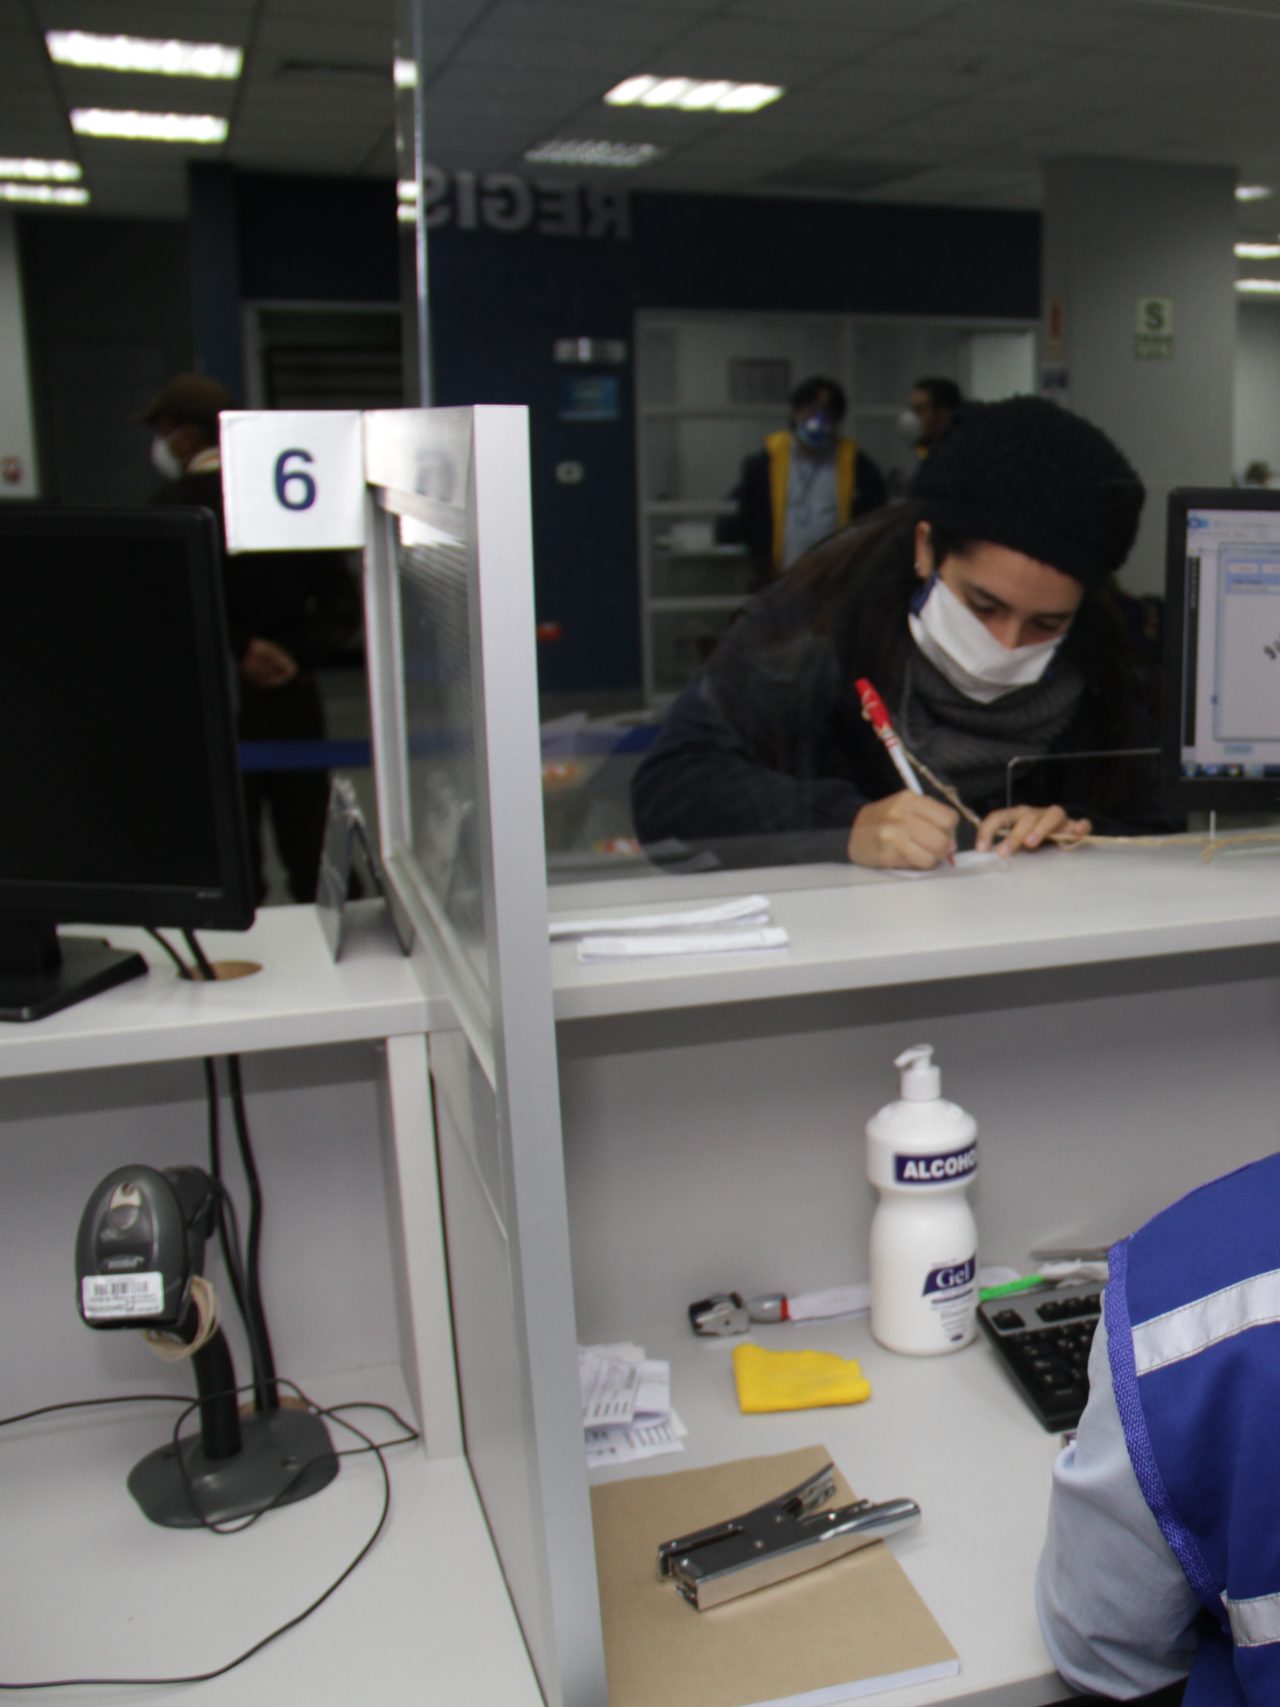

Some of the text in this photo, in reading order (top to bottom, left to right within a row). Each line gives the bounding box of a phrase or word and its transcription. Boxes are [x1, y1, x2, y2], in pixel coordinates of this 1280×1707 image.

[1145, 302, 1165, 330] S
[273, 448, 316, 511] 6
[935, 1262, 970, 1289] Gel
